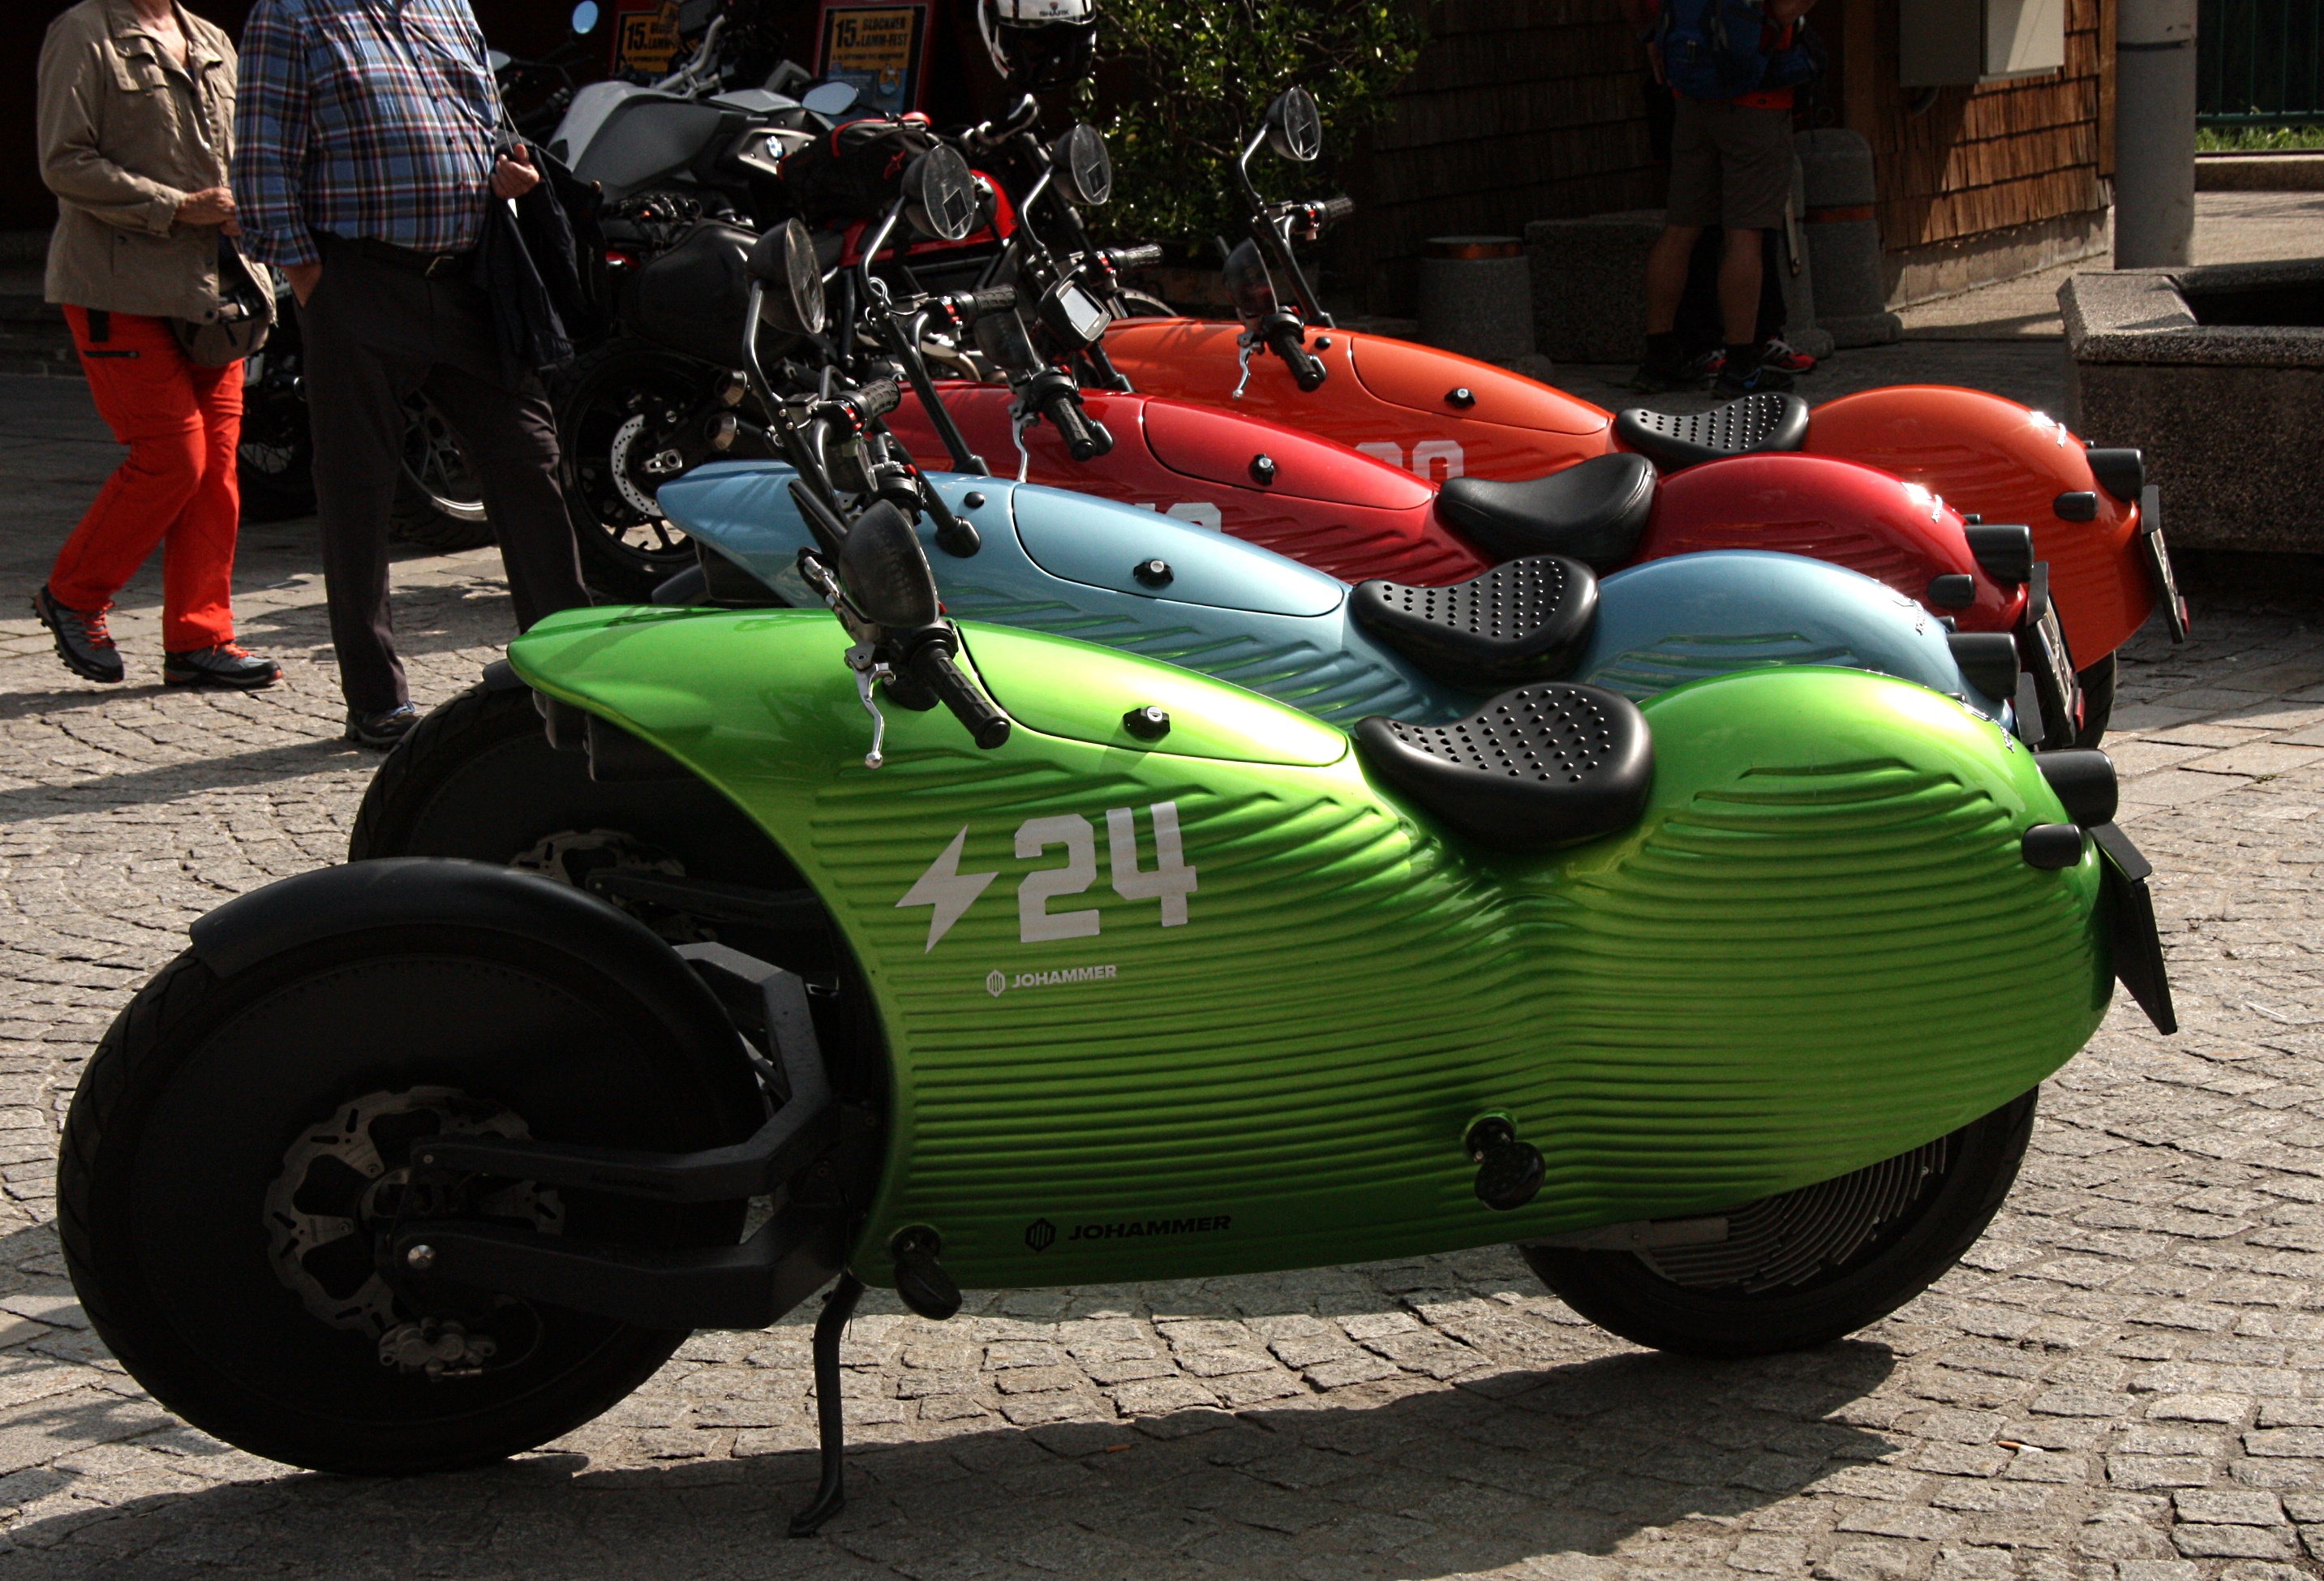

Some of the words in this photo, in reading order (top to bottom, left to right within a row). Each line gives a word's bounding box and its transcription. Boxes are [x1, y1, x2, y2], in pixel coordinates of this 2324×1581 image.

[627, 23, 647, 49] 15.
[836, 19, 860, 47] 15.
[863, 17, 906, 31] GLOCKNER
[861, 33, 909, 47] LAMM-FEST
[1015, 801, 1198, 943] 24
[1012, 964, 1117, 989] JOHAMMER
[1068, 1215, 1232, 1240] JOHAMMER
